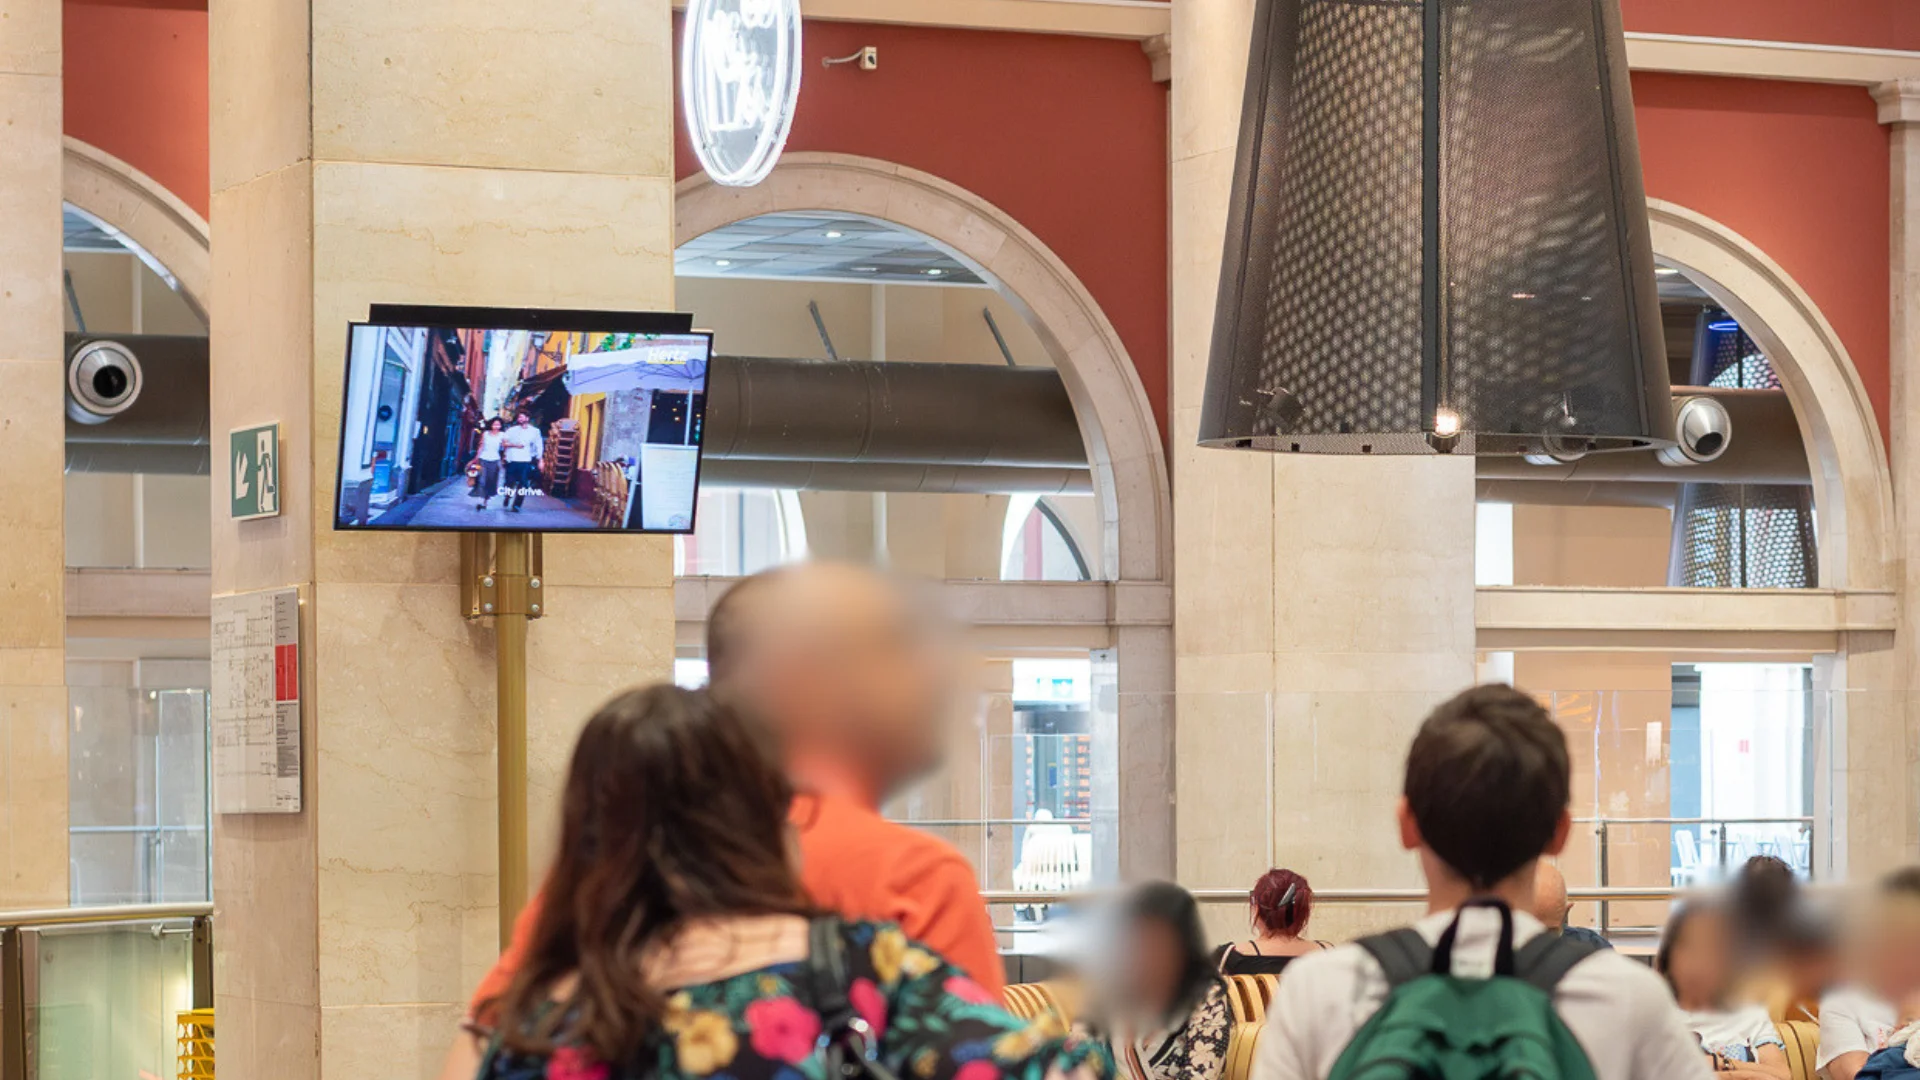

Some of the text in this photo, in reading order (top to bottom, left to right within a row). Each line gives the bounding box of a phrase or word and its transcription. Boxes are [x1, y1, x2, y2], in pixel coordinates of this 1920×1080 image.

[648, 347, 689, 362] Hertz
[497, 486, 544, 497] City drive.
